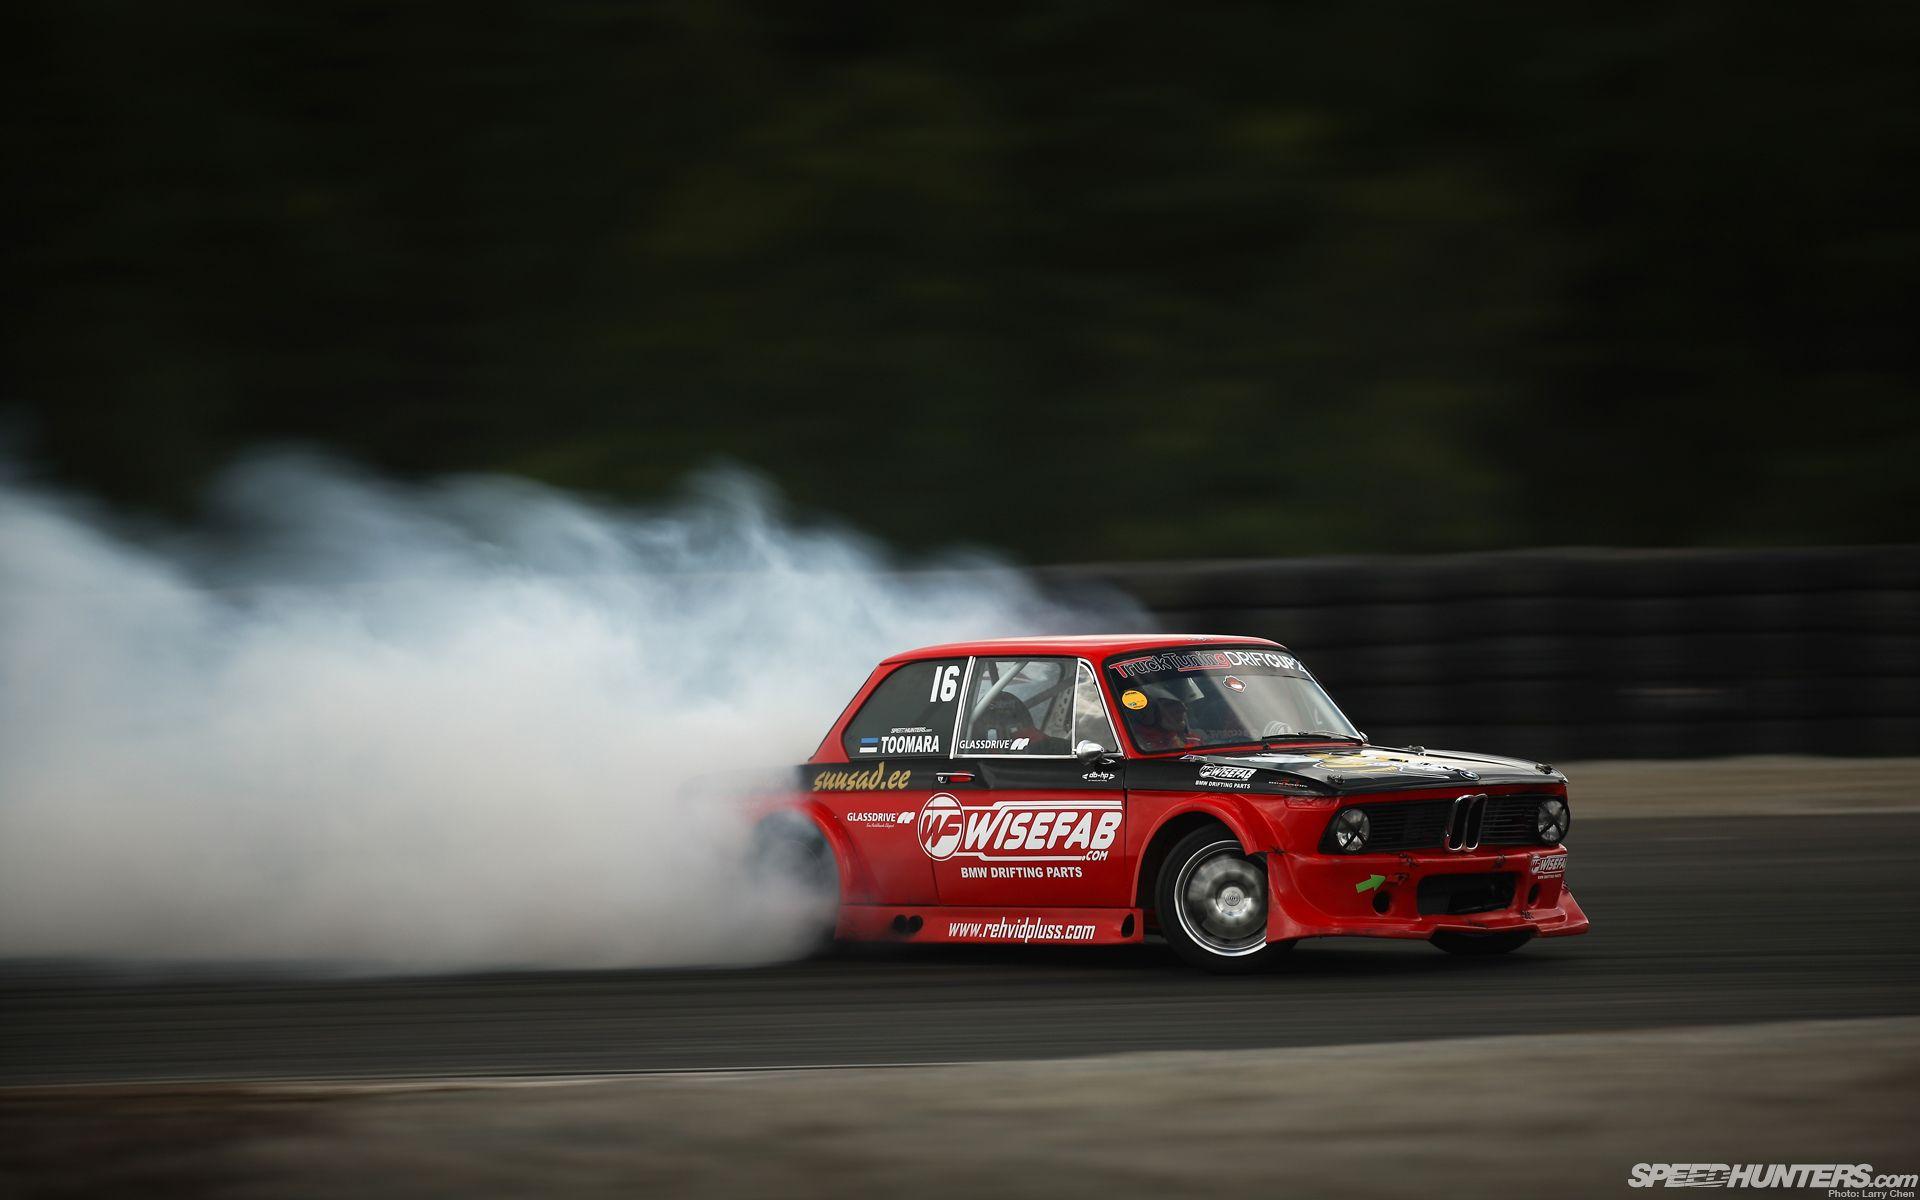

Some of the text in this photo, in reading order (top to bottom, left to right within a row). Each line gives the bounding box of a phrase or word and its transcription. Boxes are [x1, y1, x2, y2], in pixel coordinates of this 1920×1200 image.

[930, 666, 960, 702] 16
[881, 735, 939, 753] TOOMARA
[959, 739, 1010, 749] GLASSDRIVE
[813, 761, 911, 791] suusad.ee
[1208, 781, 1233, 789] DRIFTING
[847, 812, 896, 822] GLASSDRIVE
[964, 811, 1122, 850] WISEFAB
[961, 867, 1083, 878] BMW DRIFTING PARTS
[948, 917, 1096, 943] www.rehvidpluss.com
